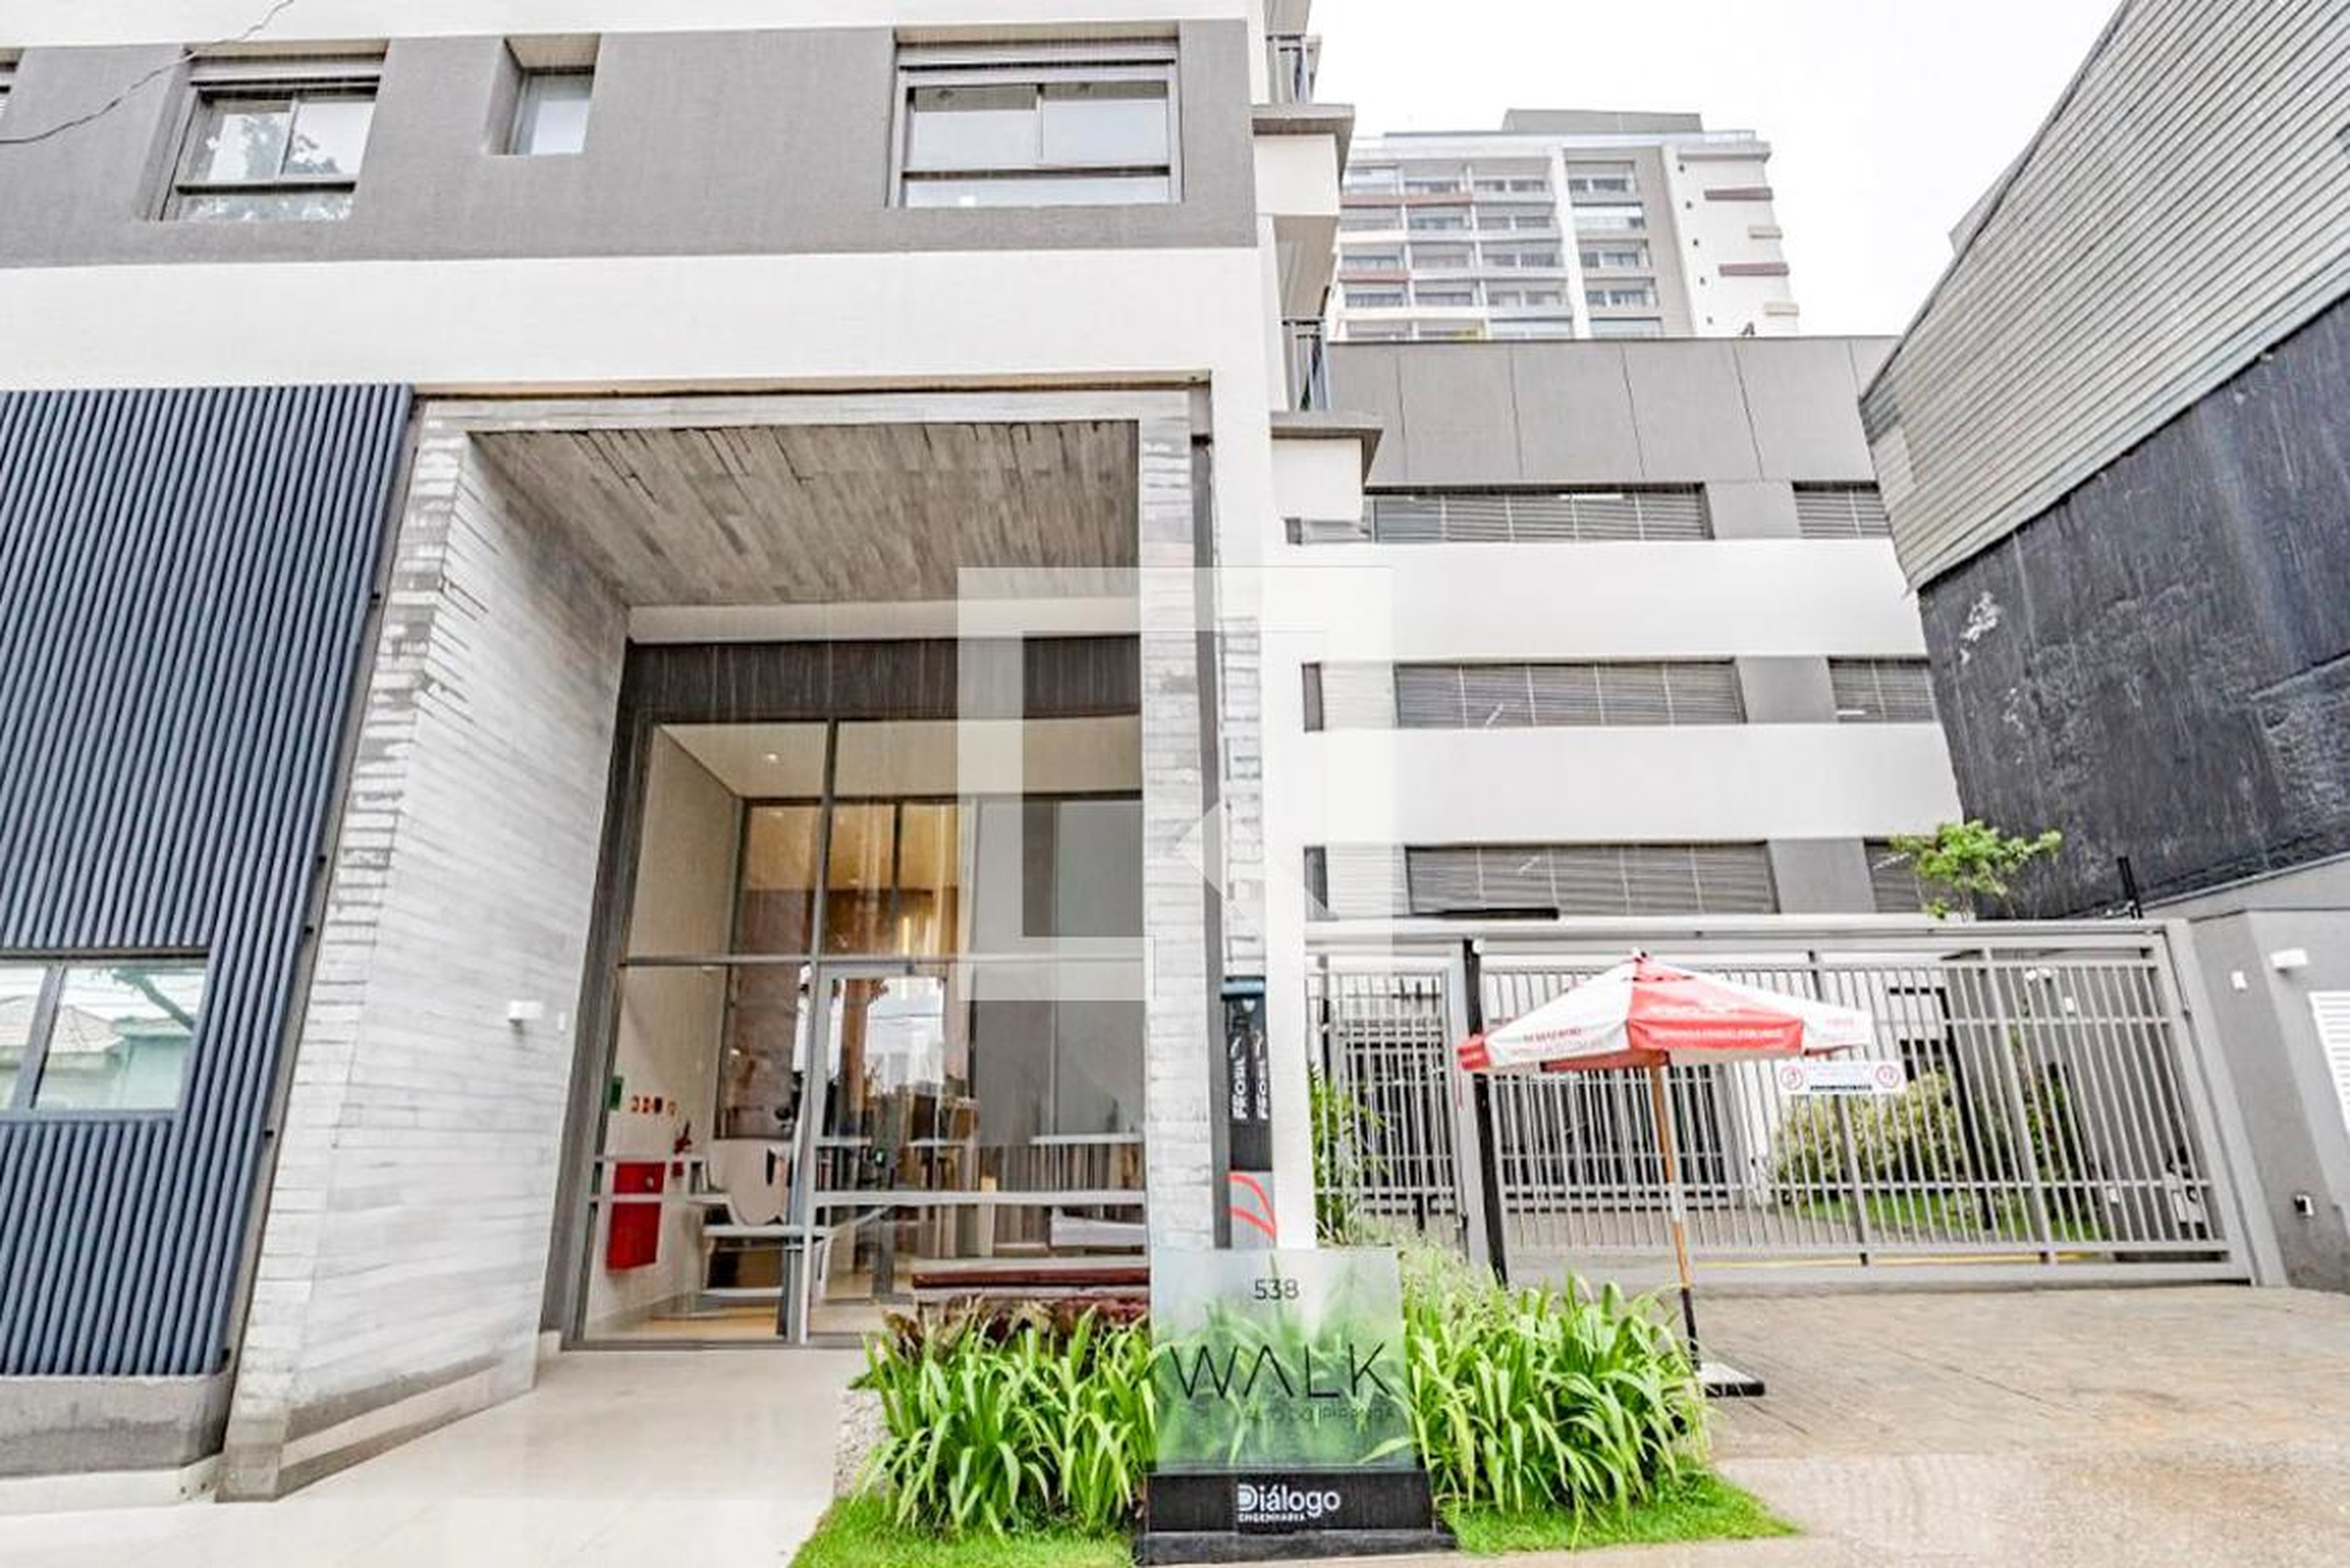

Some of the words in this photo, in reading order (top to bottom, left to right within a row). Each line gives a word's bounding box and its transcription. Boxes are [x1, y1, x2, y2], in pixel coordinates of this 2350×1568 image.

[1254, 1279, 1299, 1300] 538
[1169, 1342, 1391, 1399] WALK
[1237, 1483, 1341, 1518] Diálogo
